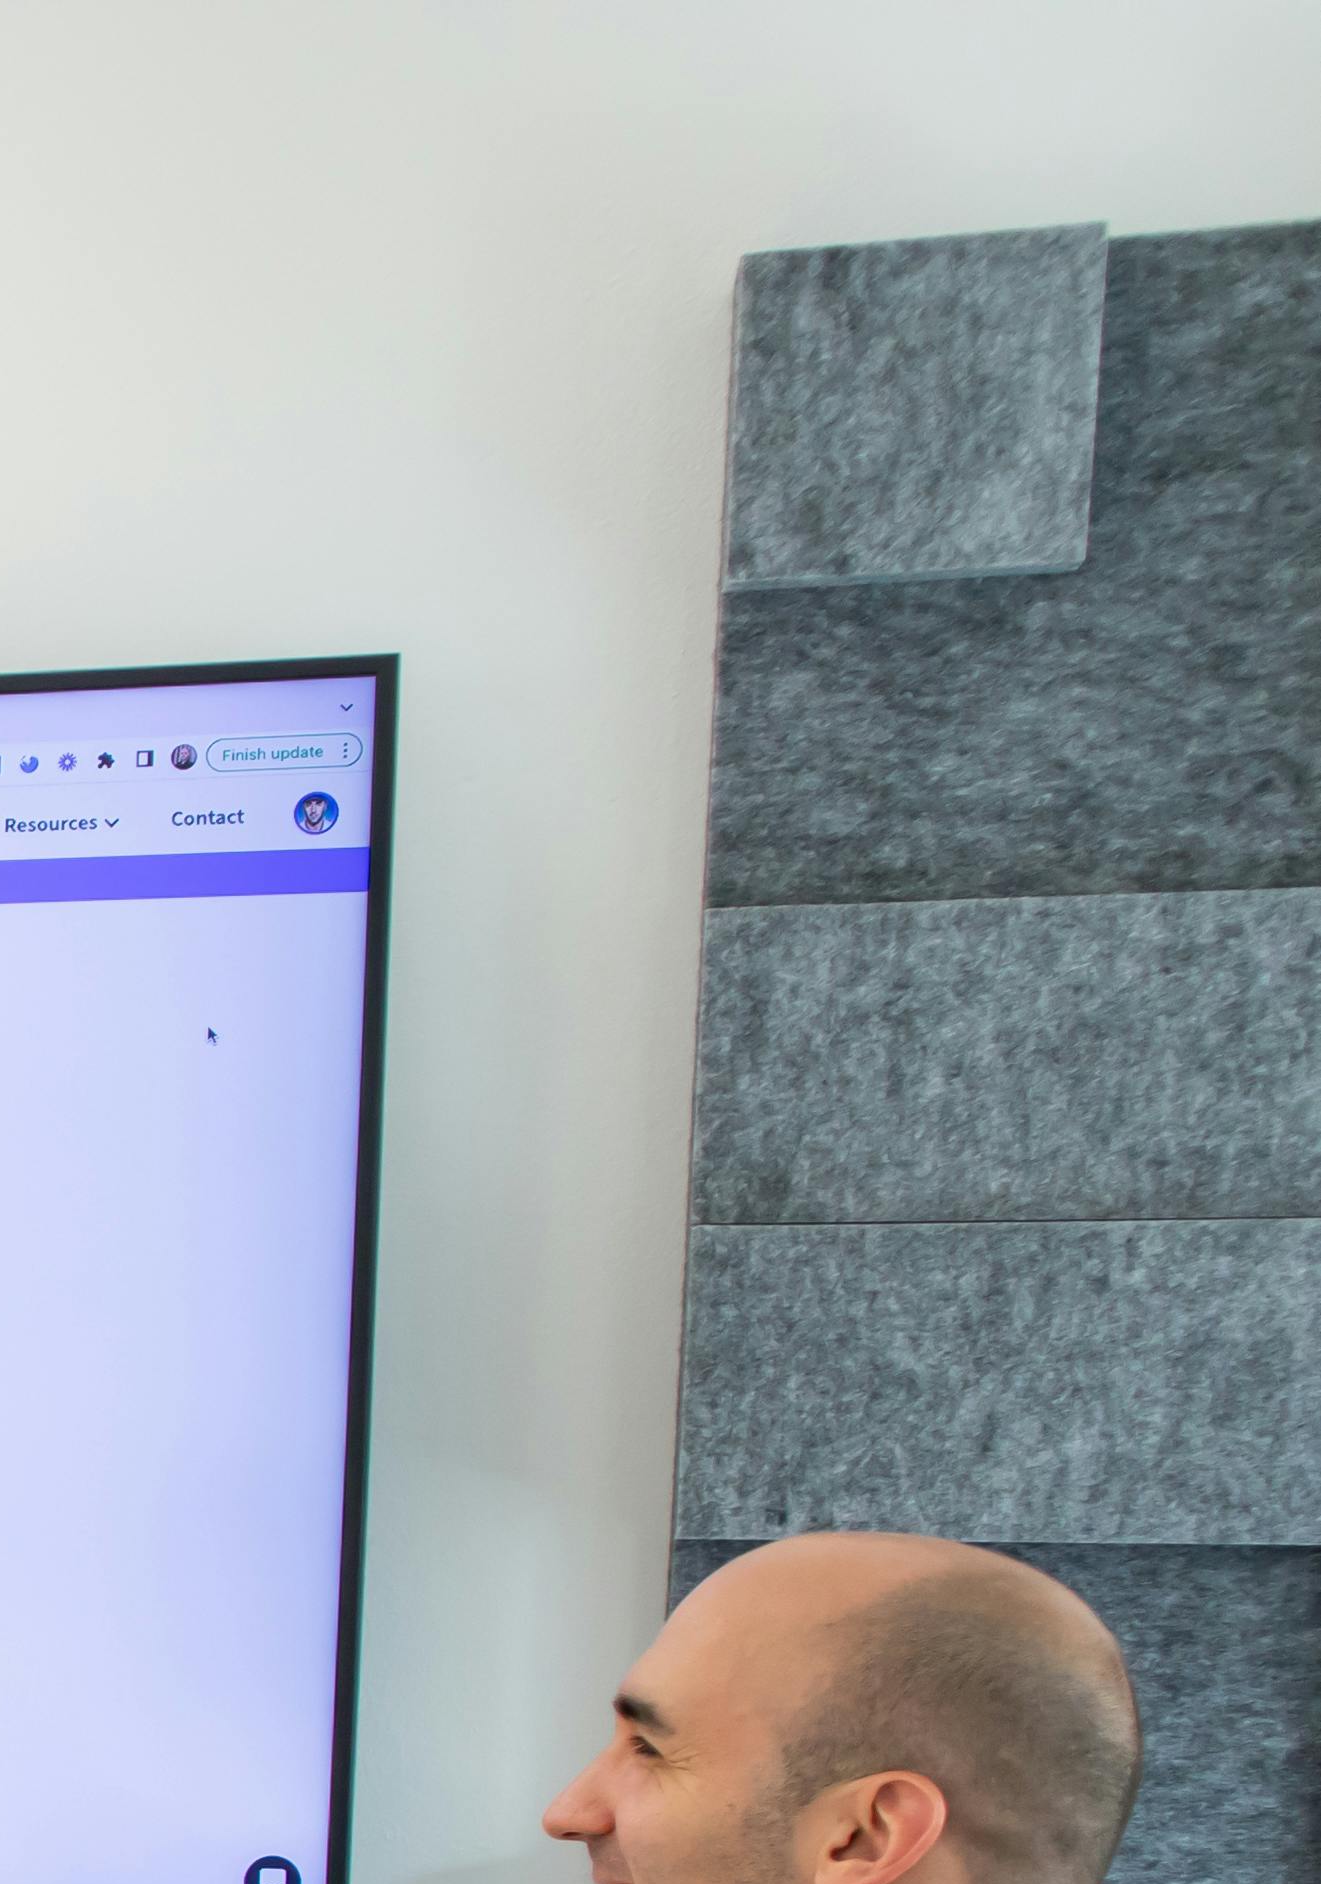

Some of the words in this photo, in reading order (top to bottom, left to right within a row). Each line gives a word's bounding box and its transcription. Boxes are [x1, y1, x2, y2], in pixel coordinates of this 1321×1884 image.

[223, 747, 265, 761] Finish
[271, 746, 324, 762] update
[4, 815, 97, 833] Resources
[171, 809, 244, 826] Contact
